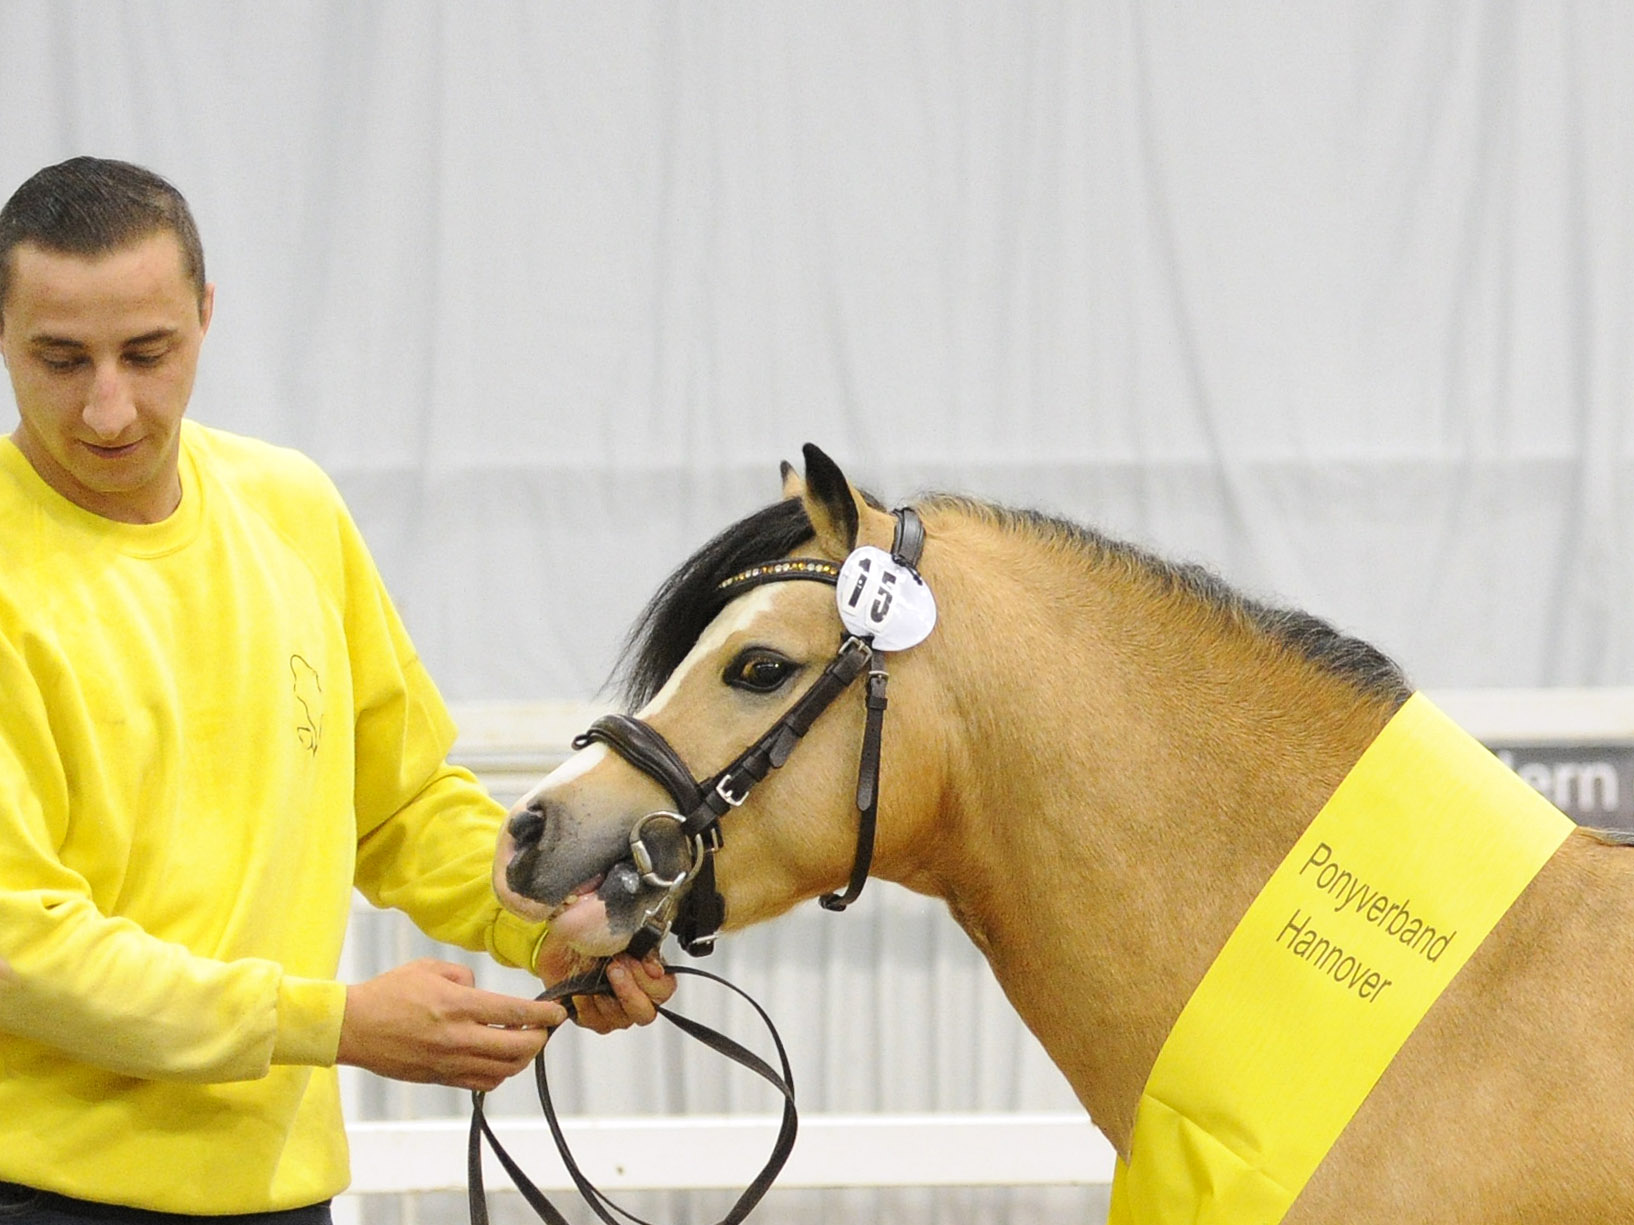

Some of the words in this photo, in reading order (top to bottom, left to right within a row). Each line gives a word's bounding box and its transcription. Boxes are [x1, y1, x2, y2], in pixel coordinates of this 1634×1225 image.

[849, 558, 896, 623] 15
[1498, 749, 1619, 811] ern
[1299, 842, 1457, 963] Ponyverband
[1276, 908, 1392, 1003] Hannover
